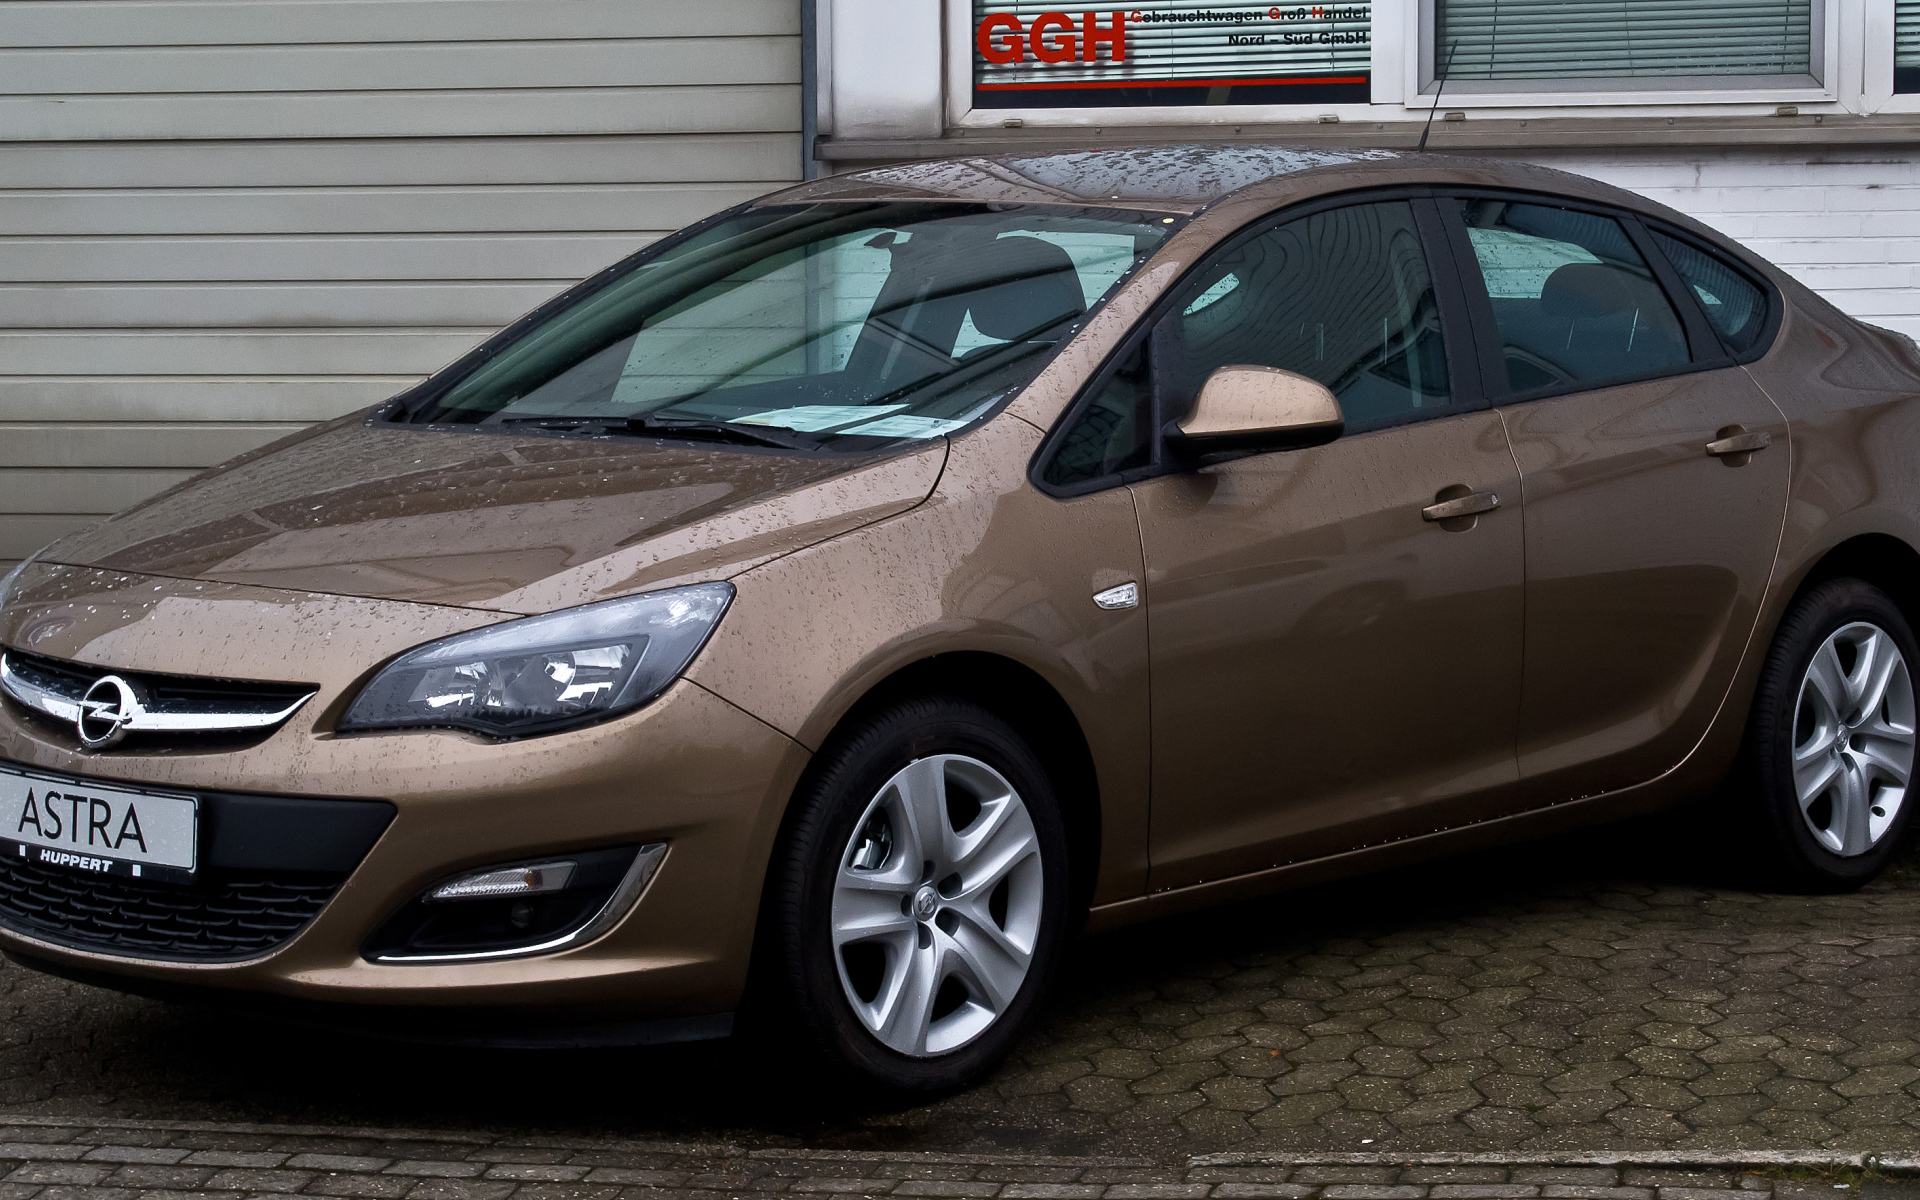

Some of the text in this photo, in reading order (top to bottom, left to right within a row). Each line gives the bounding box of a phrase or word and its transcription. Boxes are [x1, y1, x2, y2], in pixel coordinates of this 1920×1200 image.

[1130, 6, 1367, 23] Gebrauchtwagen Groß Handel
[977, 11, 1125, 64] GGH
[1228, 34, 1265, 46] Nord
[1283, 32, 1313, 45] Süd
[1318, 32, 1367, 45] GmbH
[18, 787, 147, 853] ASTRA
[40, 850, 113, 873] HUPPERT
